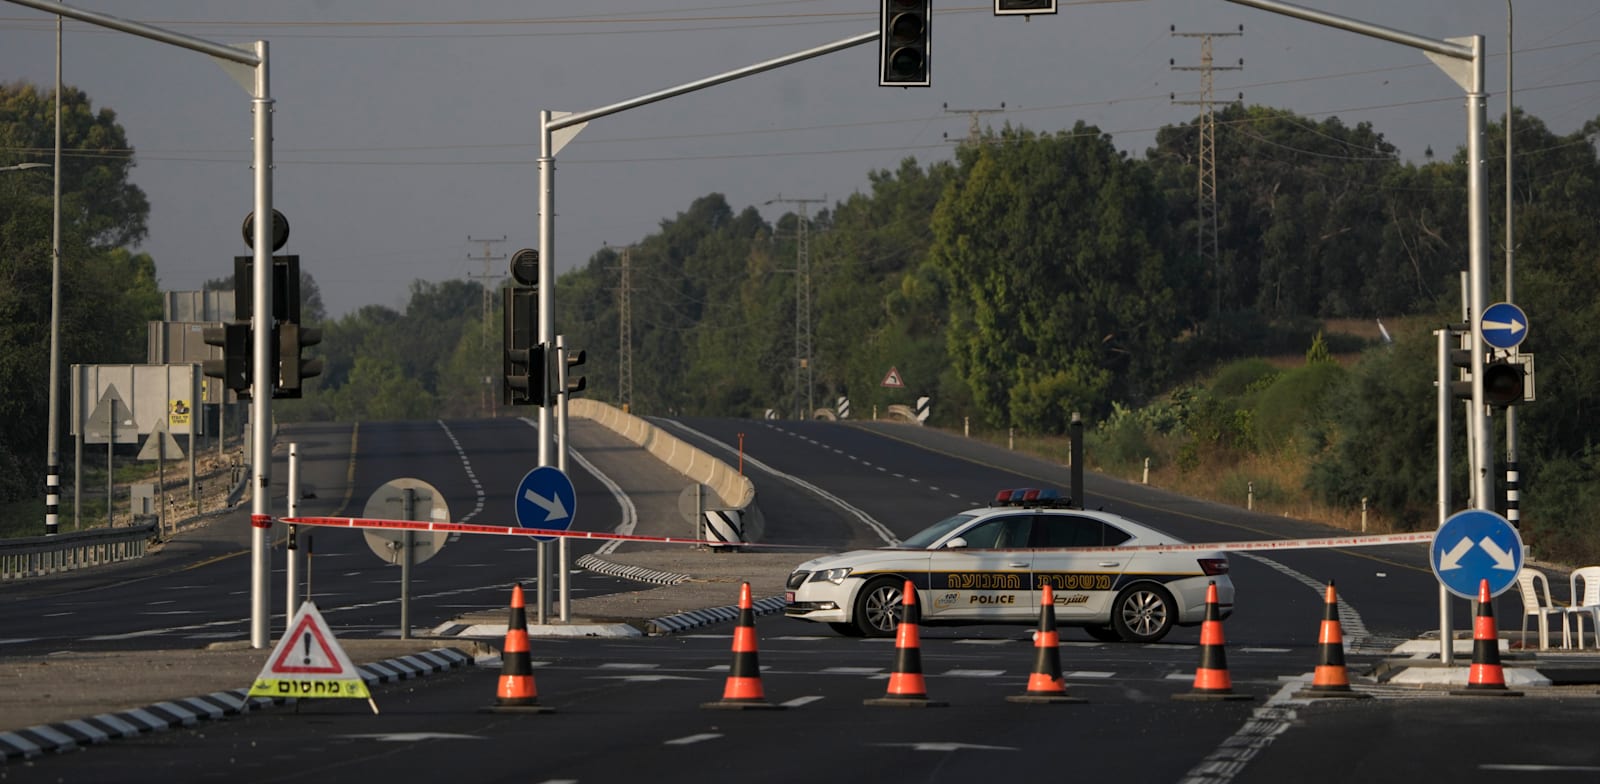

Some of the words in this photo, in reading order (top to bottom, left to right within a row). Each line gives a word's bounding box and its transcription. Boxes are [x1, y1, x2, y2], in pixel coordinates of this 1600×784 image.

[948, 573, 1021, 589] התנועה
[1037, 574, 1111, 589] משטרת
[970, 595, 1015, 604] POLICE
[1053, 593, 1089, 605] الشرط
[278, 681, 340, 693] מחסום
